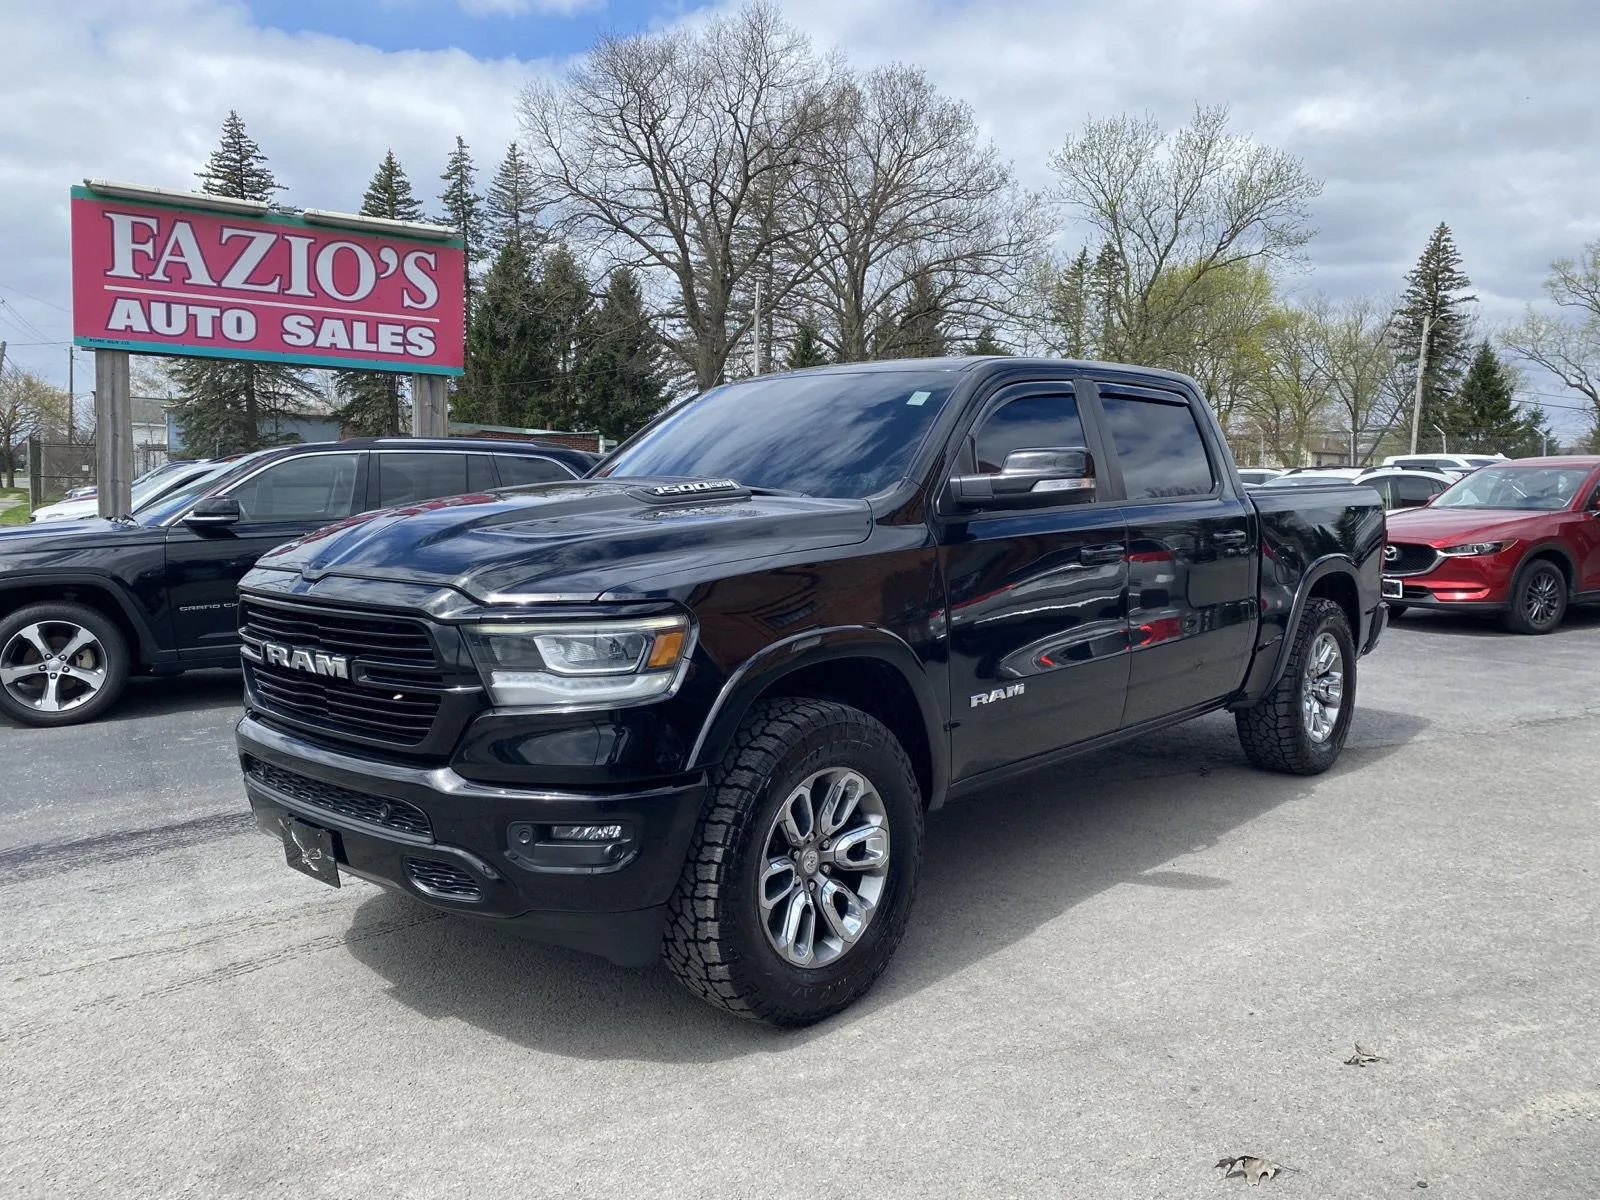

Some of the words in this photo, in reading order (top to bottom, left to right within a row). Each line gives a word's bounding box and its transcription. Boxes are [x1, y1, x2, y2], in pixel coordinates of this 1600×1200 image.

[104, 211, 440, 311] FAZIO'S
[105, 298, 258, 344] AUTO
[282, 314, 437, 358] SALES
[654, 482, 711, 495] 1500
[179, 604, 220, 612] GRAND
[266, 643, 349, 680] RAM
[970, 683, 1025, 708] RAM
